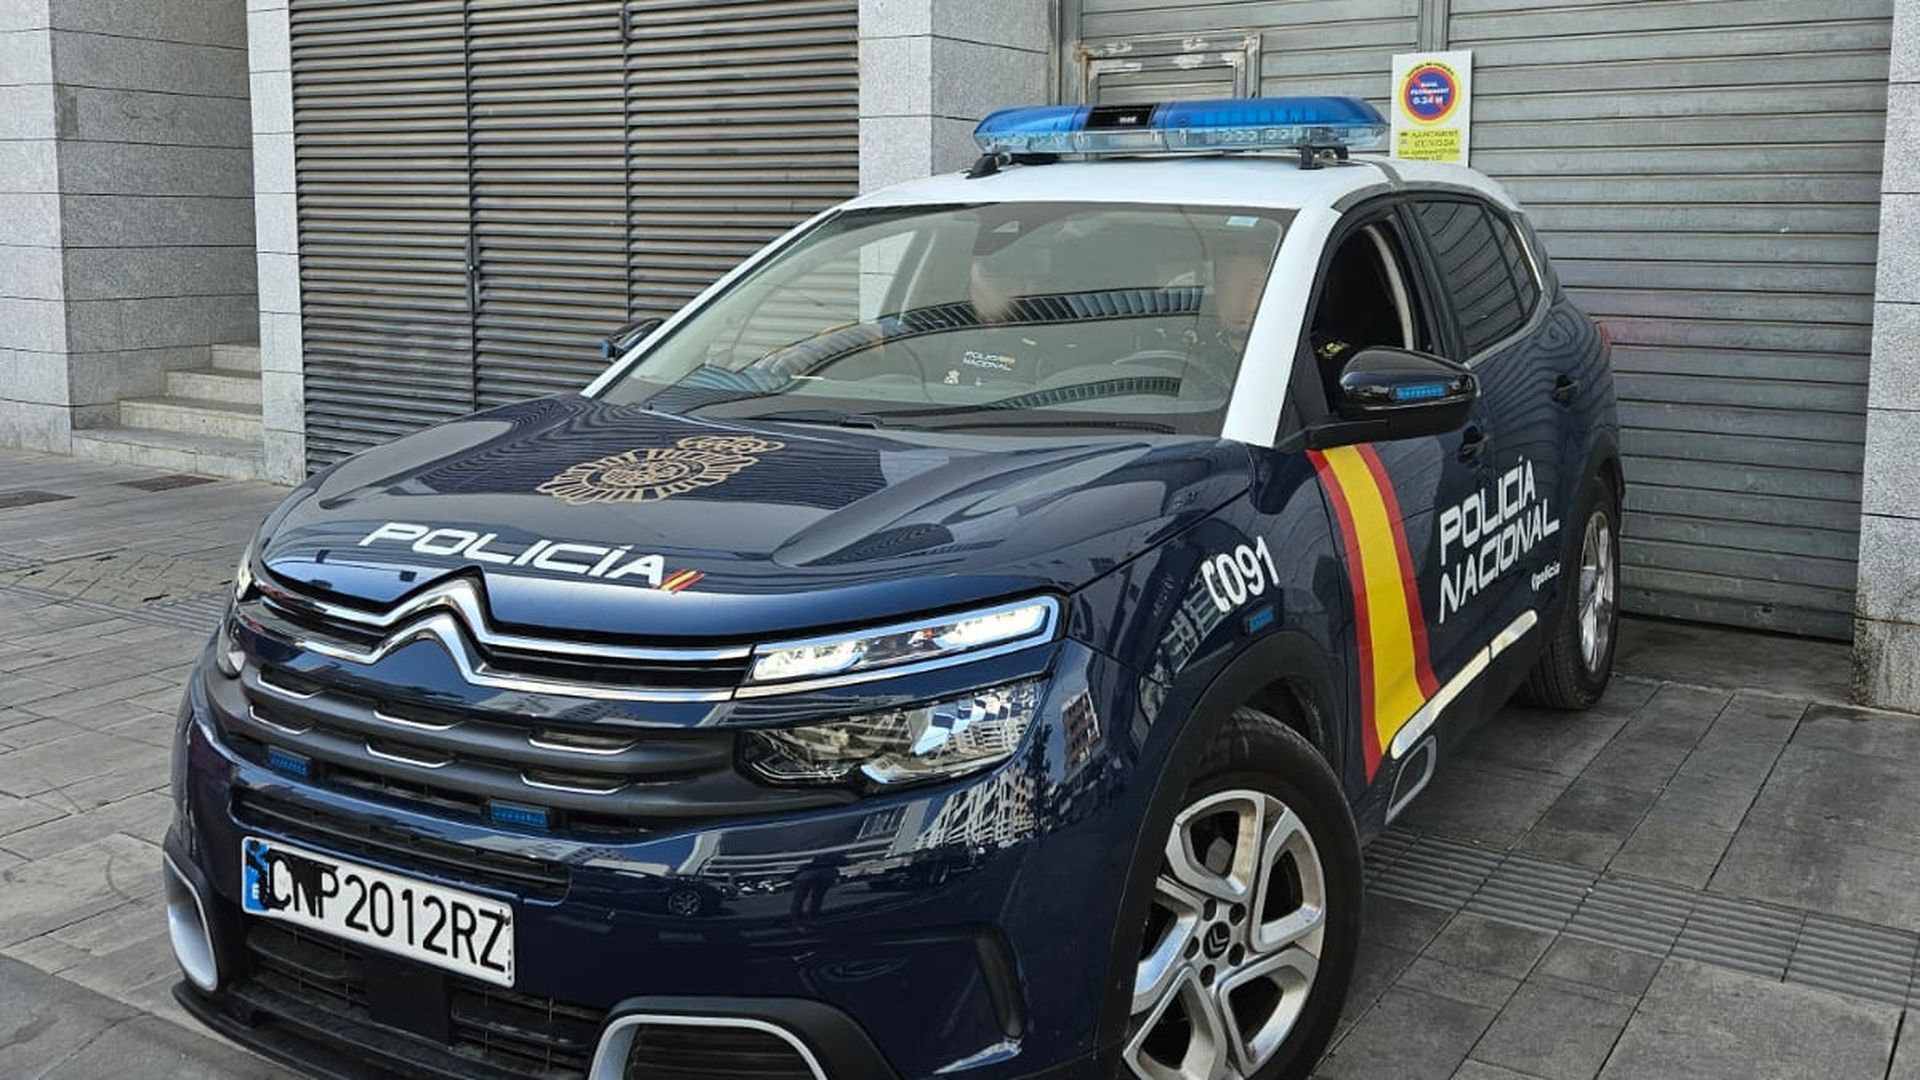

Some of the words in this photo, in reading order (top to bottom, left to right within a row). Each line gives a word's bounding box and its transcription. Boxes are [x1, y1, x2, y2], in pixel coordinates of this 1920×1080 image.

[359, 522, 664, 587] POLICÍA
[1440, 455, 1536, 566] POLICÍA
[1440, 498, 1560, 624] NACIONAL
